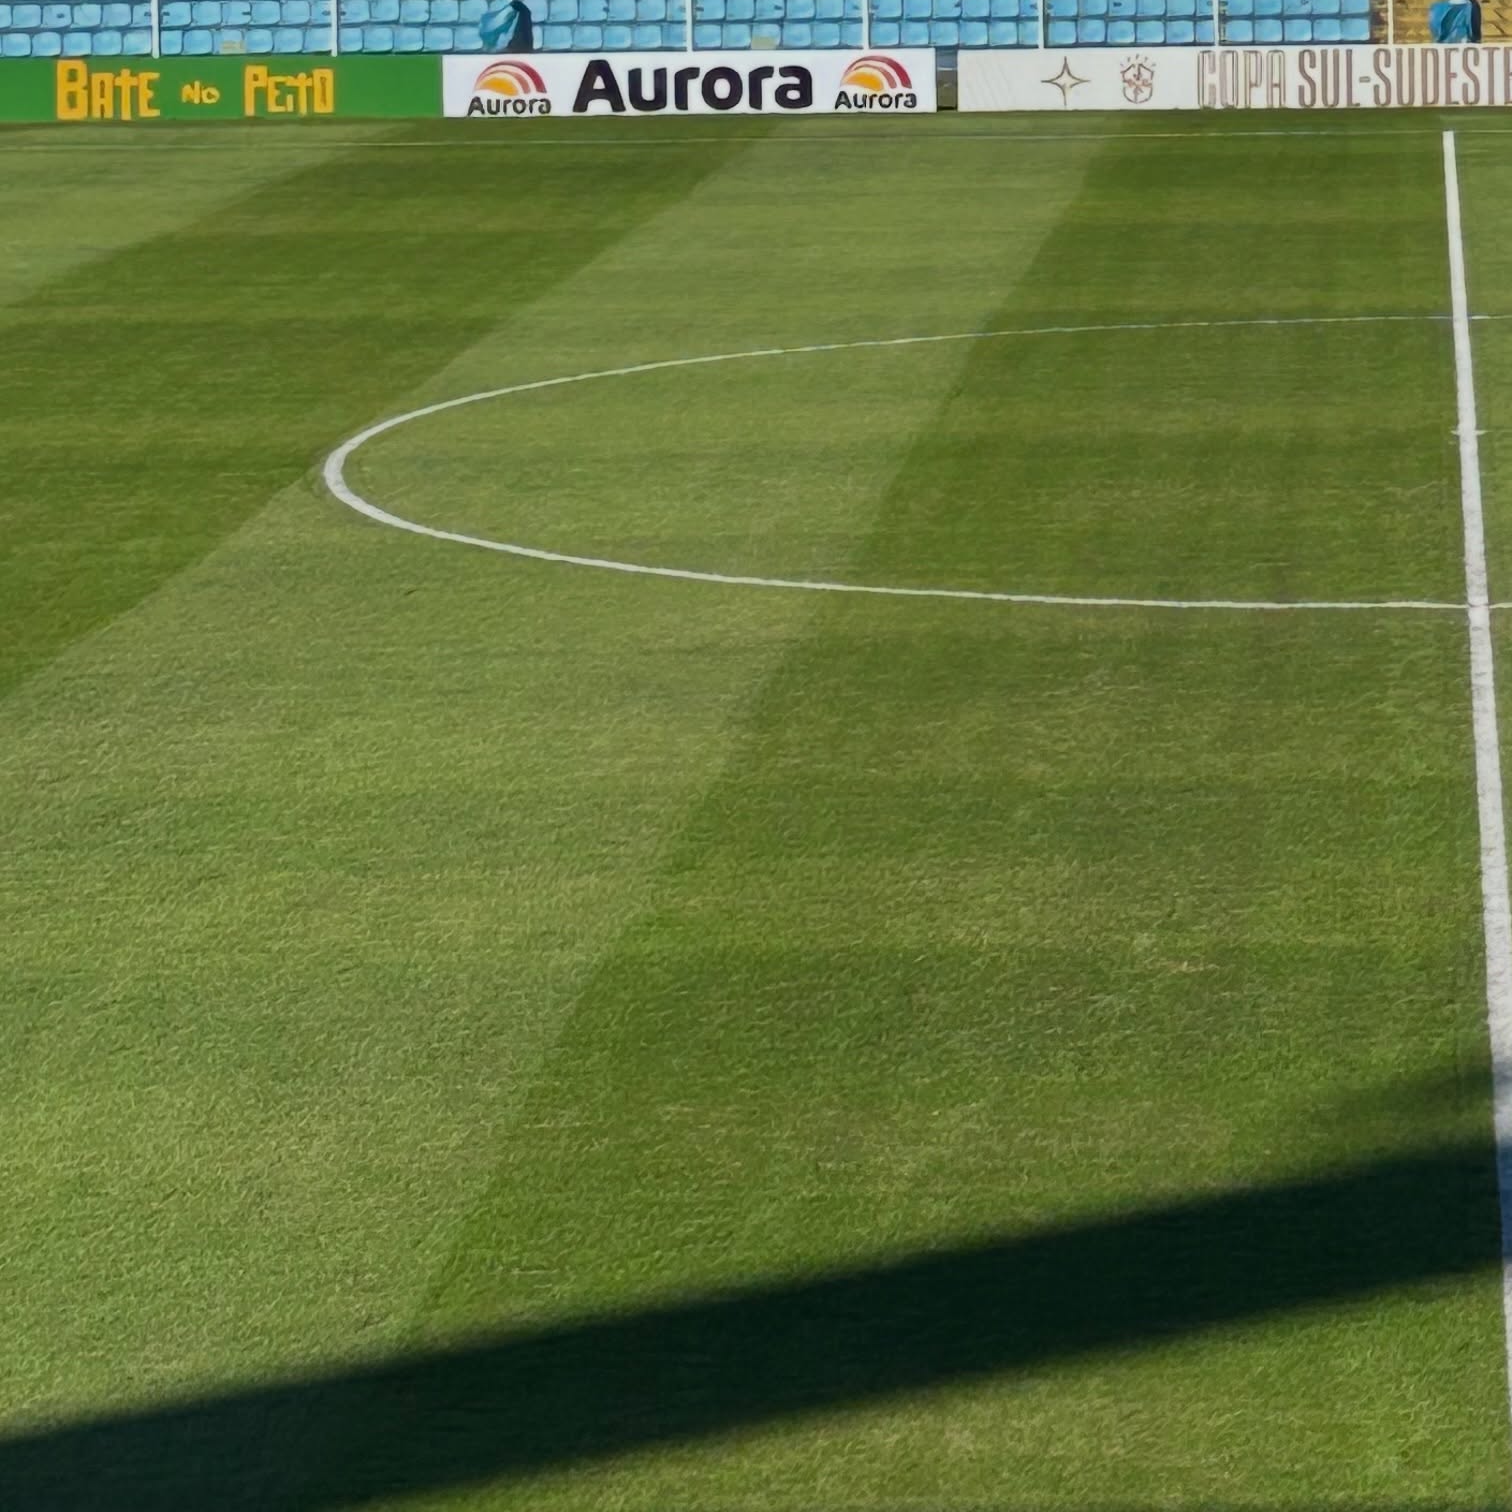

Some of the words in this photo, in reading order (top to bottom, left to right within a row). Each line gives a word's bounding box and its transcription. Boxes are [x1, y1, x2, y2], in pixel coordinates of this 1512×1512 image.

[572, 59, 814, 113] Aurora
[1197, 49, 1288, 108] COPA
[467, 96, 552, 116] Aurora
[834, 90, 918, 111] Aurora
